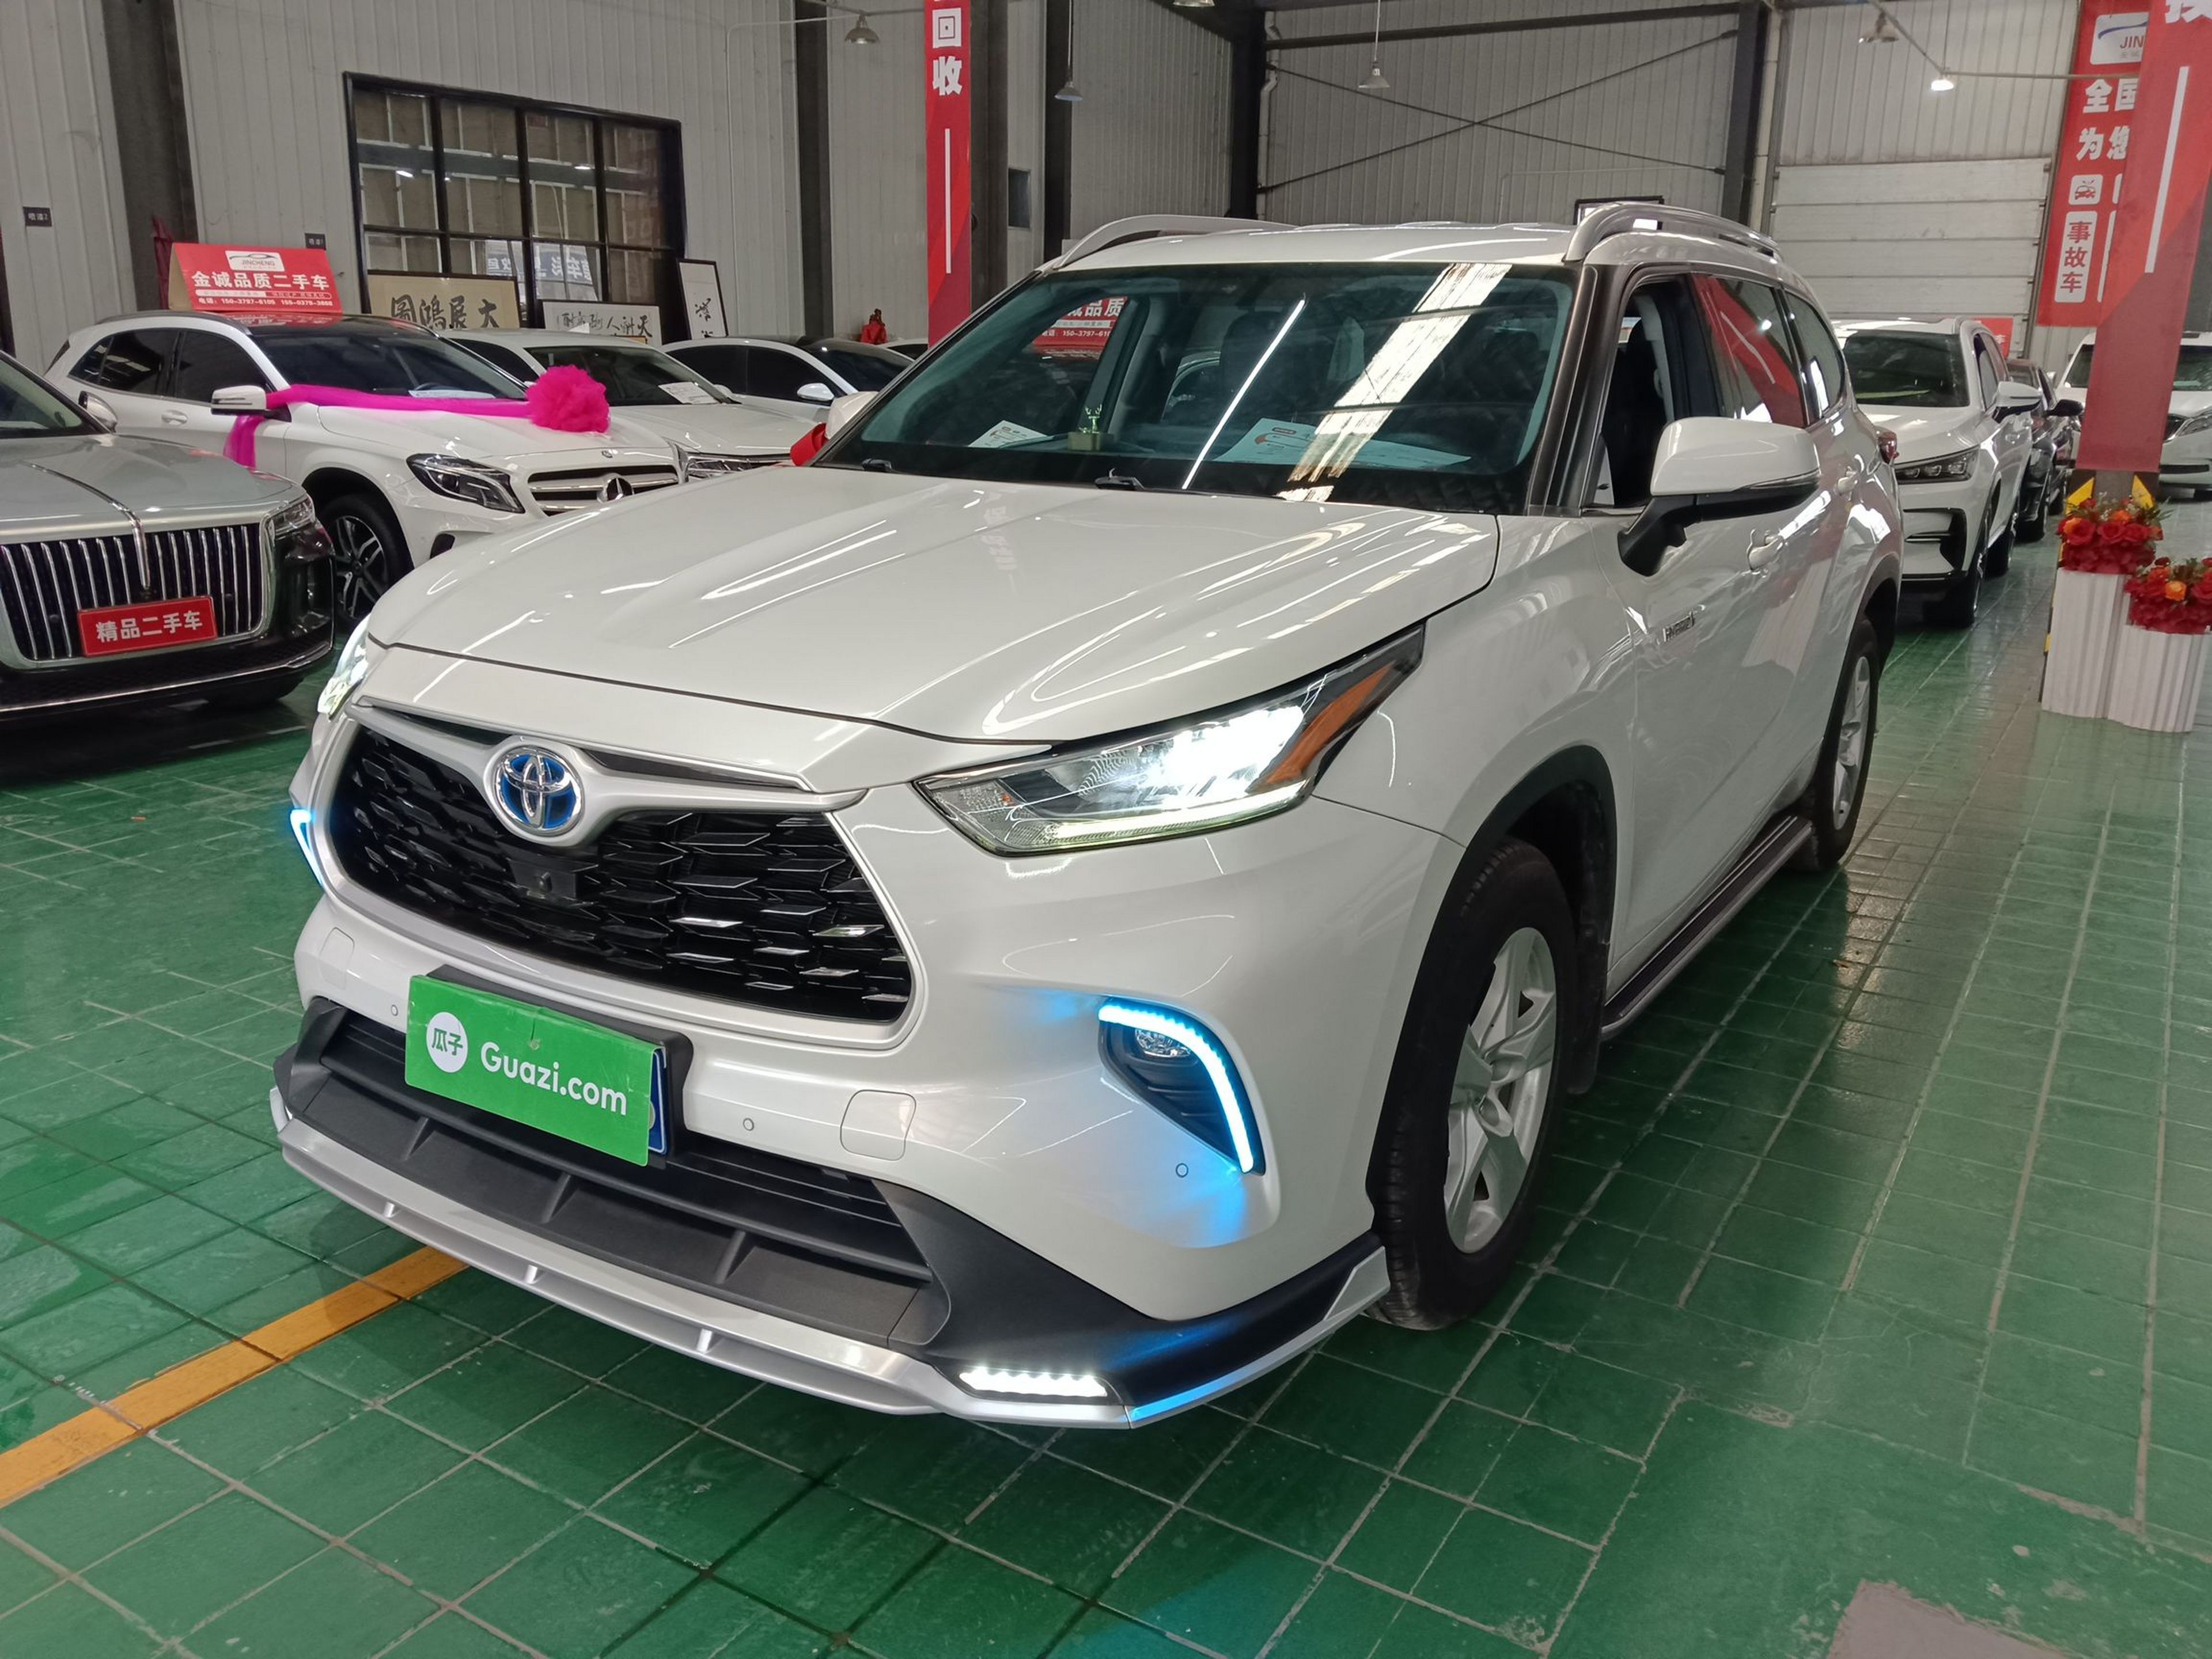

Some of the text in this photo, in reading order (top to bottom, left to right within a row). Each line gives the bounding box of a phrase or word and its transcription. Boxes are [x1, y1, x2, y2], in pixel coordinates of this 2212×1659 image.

[932, 7, 963, 97] 回收
[191, 270, 330, 290] 金诚品质二手车
[2060, 221, 2093, 294] 事故车
[95, 610, 203, 643] 精品二手车
[431, 1027, 463, 1056] 瓜子
[480, 1041, 627, 1116] Guazi.com
